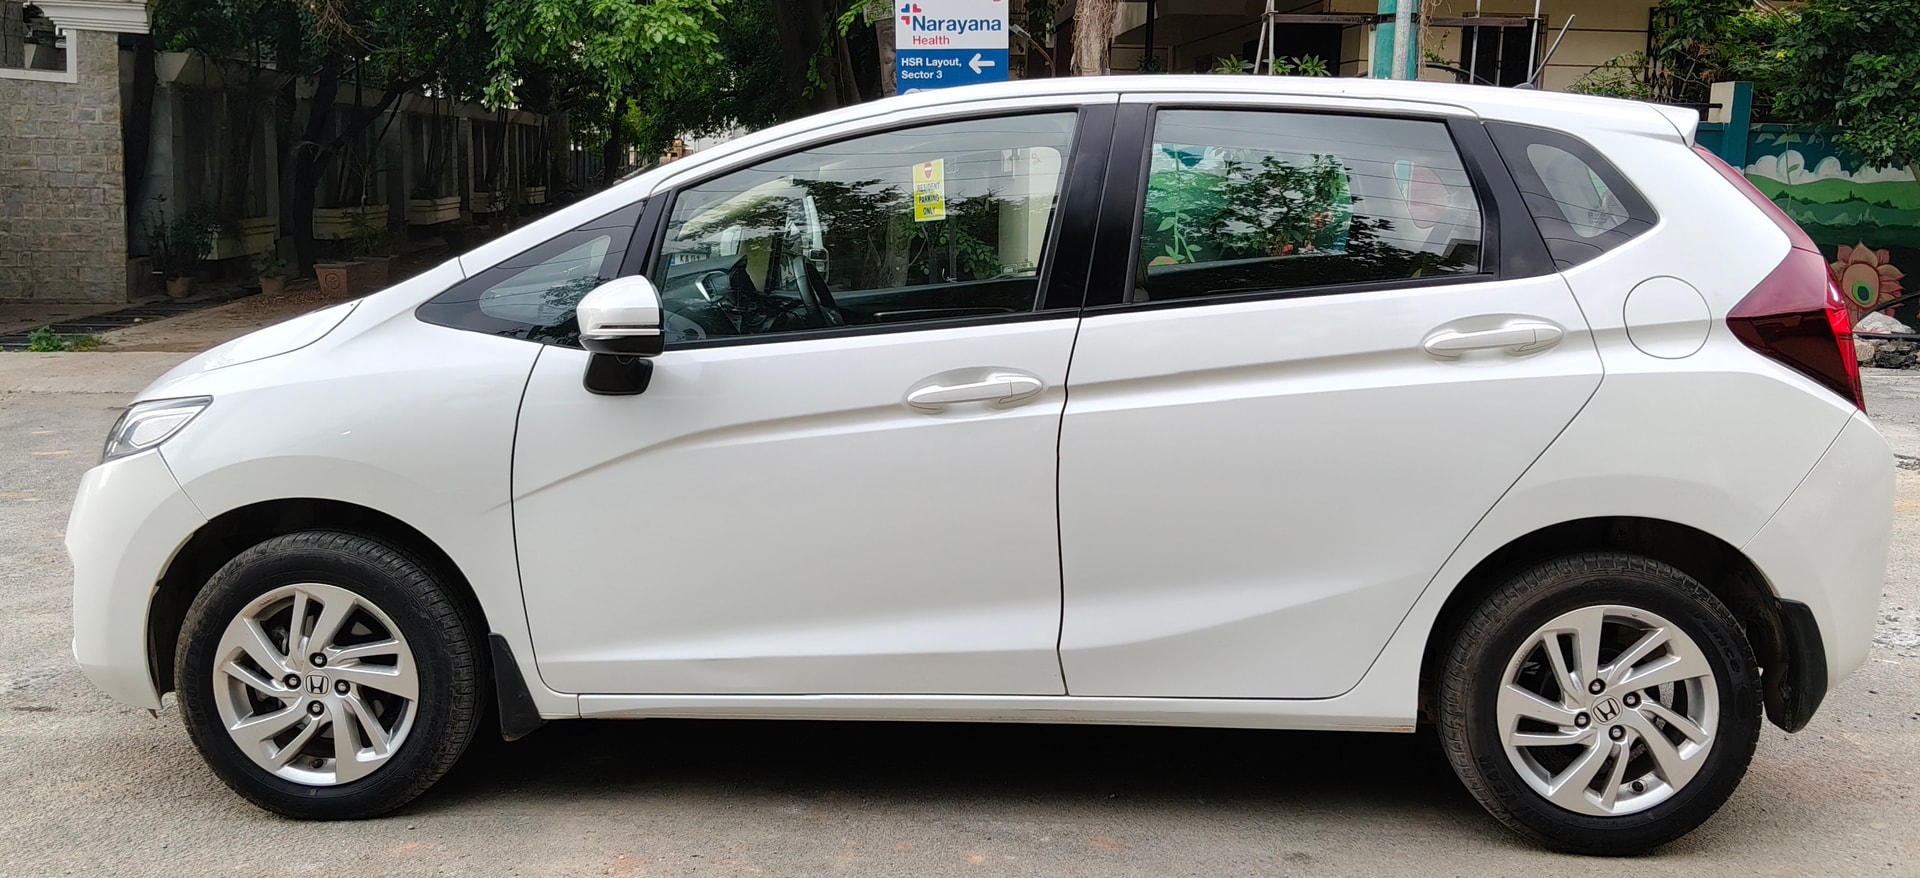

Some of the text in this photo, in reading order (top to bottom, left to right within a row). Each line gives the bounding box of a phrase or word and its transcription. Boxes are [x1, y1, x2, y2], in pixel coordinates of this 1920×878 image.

[912, 15, 1002, 34] Narayana
[912, 35, 950, 46] Health
[901, 57, 962, 68] HSR Layout,
[901, 69, 943, 79] Sector 3
[917, 182, 940, 192] RESIDENT
[918, 193, 940, 204] PARKING
[923, 206, 936, 215] ONLY
